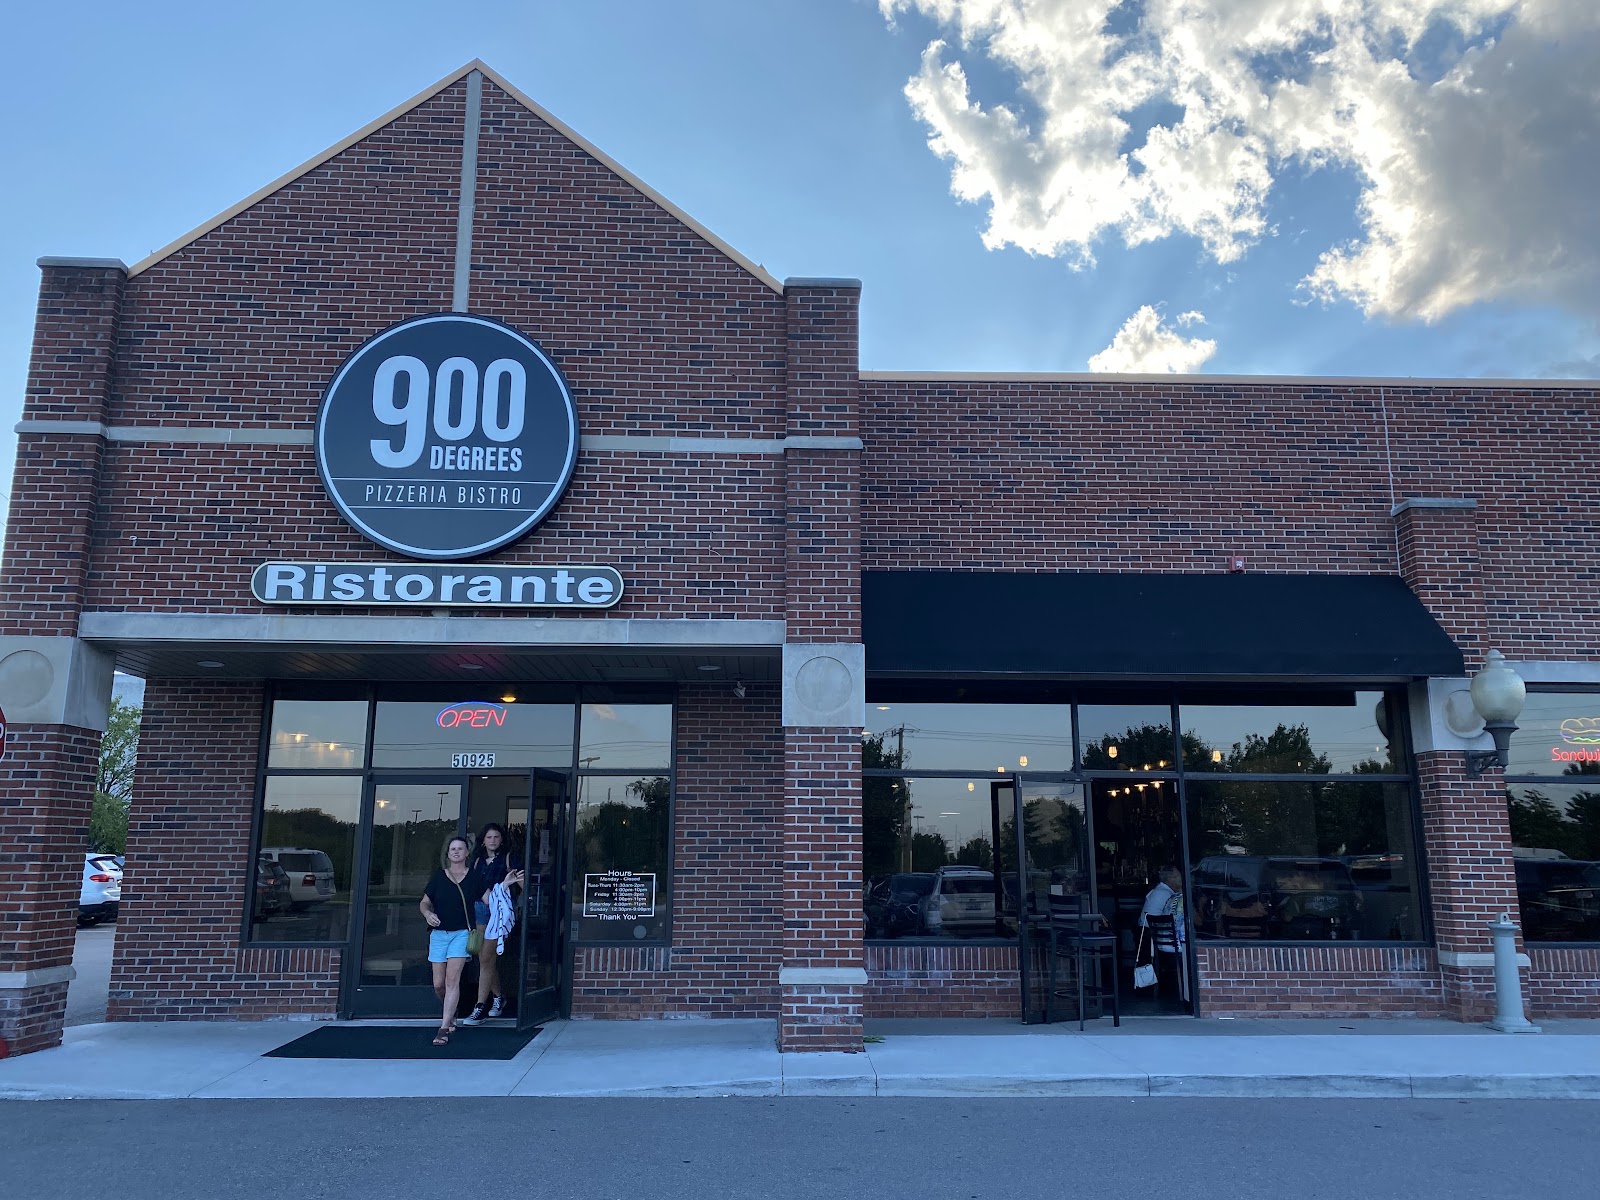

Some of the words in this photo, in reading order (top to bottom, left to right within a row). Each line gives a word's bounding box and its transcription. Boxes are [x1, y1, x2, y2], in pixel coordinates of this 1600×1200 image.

[370, 355, 527, 468] 900
[430, 446, 523, 472] DEGREES
[365, 484, 447, 503] PIZZERIA
[457, 486, 521, 505] BISTRO
[264, 565, 614, 603] Ristorante
[440, 709, 507, 727] OPEN
[452, 753, 494, 768] 50925
